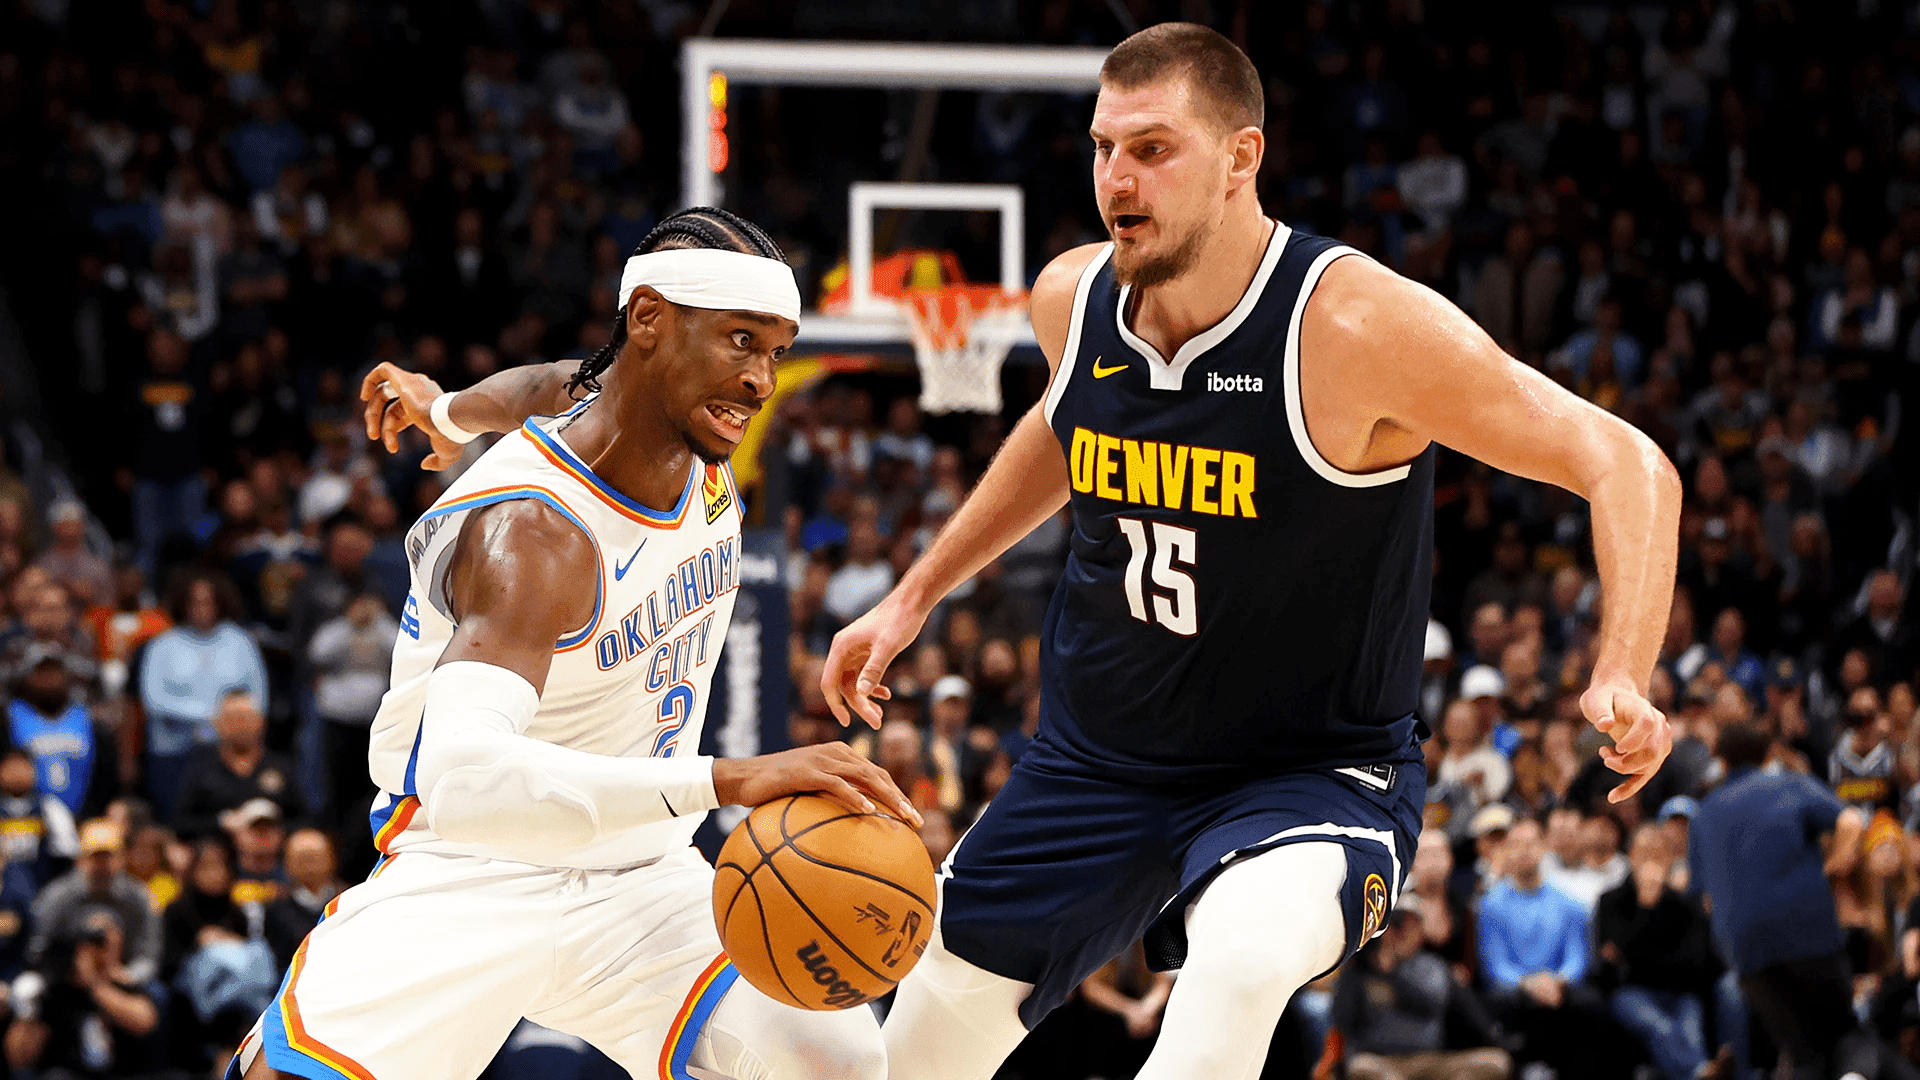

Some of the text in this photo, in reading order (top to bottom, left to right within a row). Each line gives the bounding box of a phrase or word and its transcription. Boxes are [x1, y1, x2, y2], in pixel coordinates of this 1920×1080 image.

[1206, 372, 1264, 393] ibotta
[1069, 426, 1259, 519] DENVER
[1115, 516, 1198, 637] 15
[645, 610, 715, 693] CITY
[649, 680, 696, 758] 2
